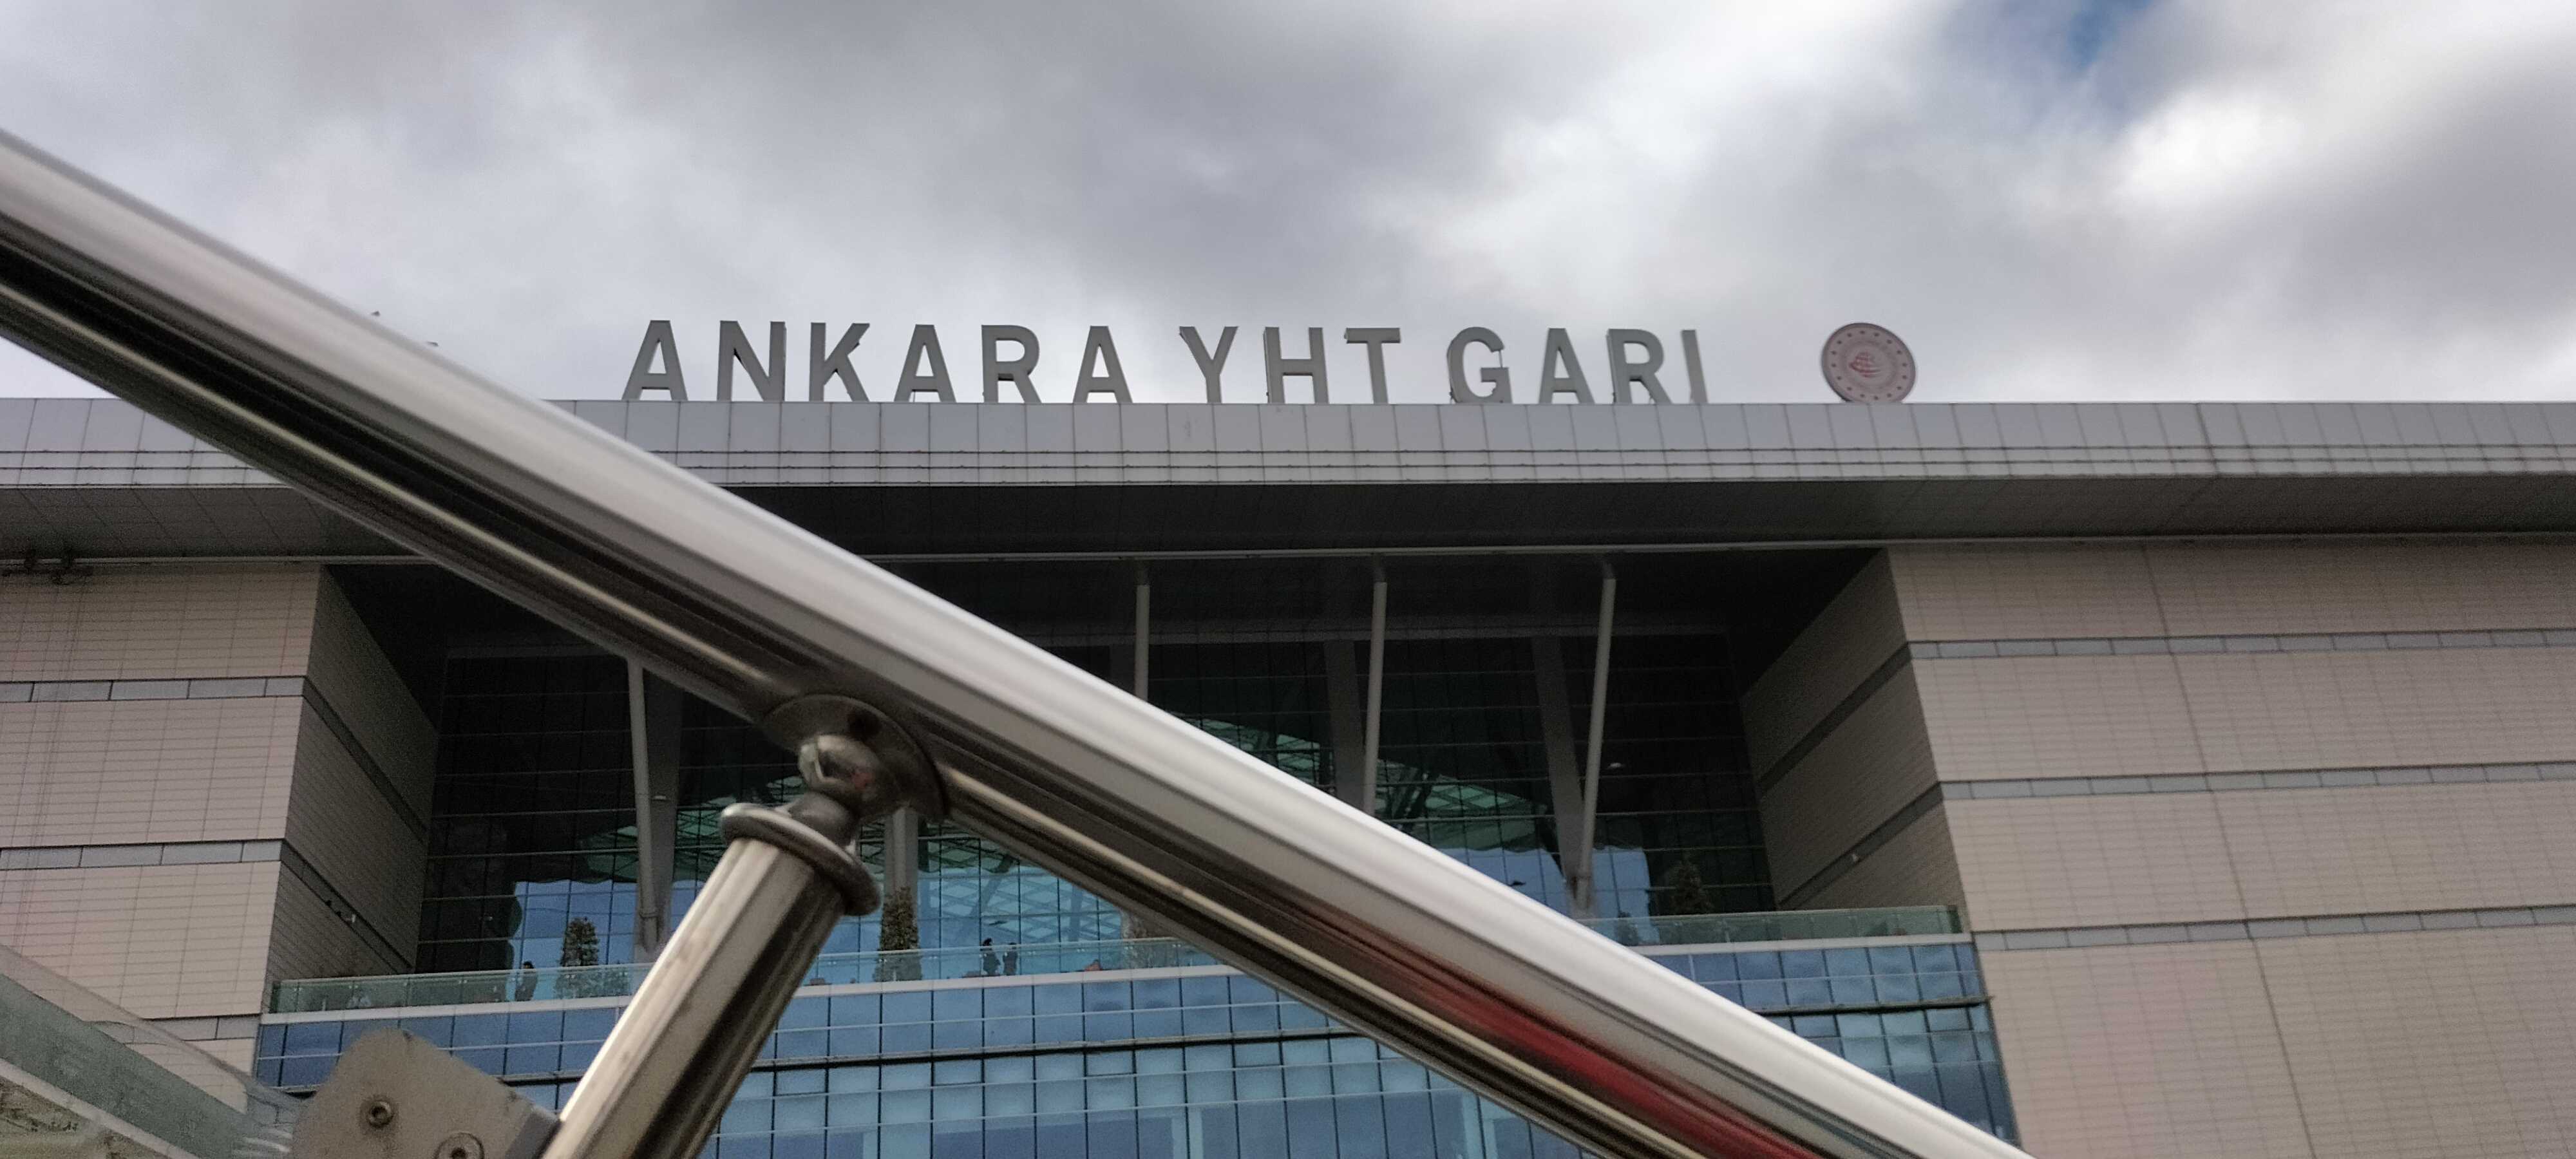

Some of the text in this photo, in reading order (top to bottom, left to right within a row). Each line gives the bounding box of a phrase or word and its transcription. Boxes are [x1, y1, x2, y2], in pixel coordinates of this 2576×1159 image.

[621, 319, 1709, 404] ANKARA YHT GARI
